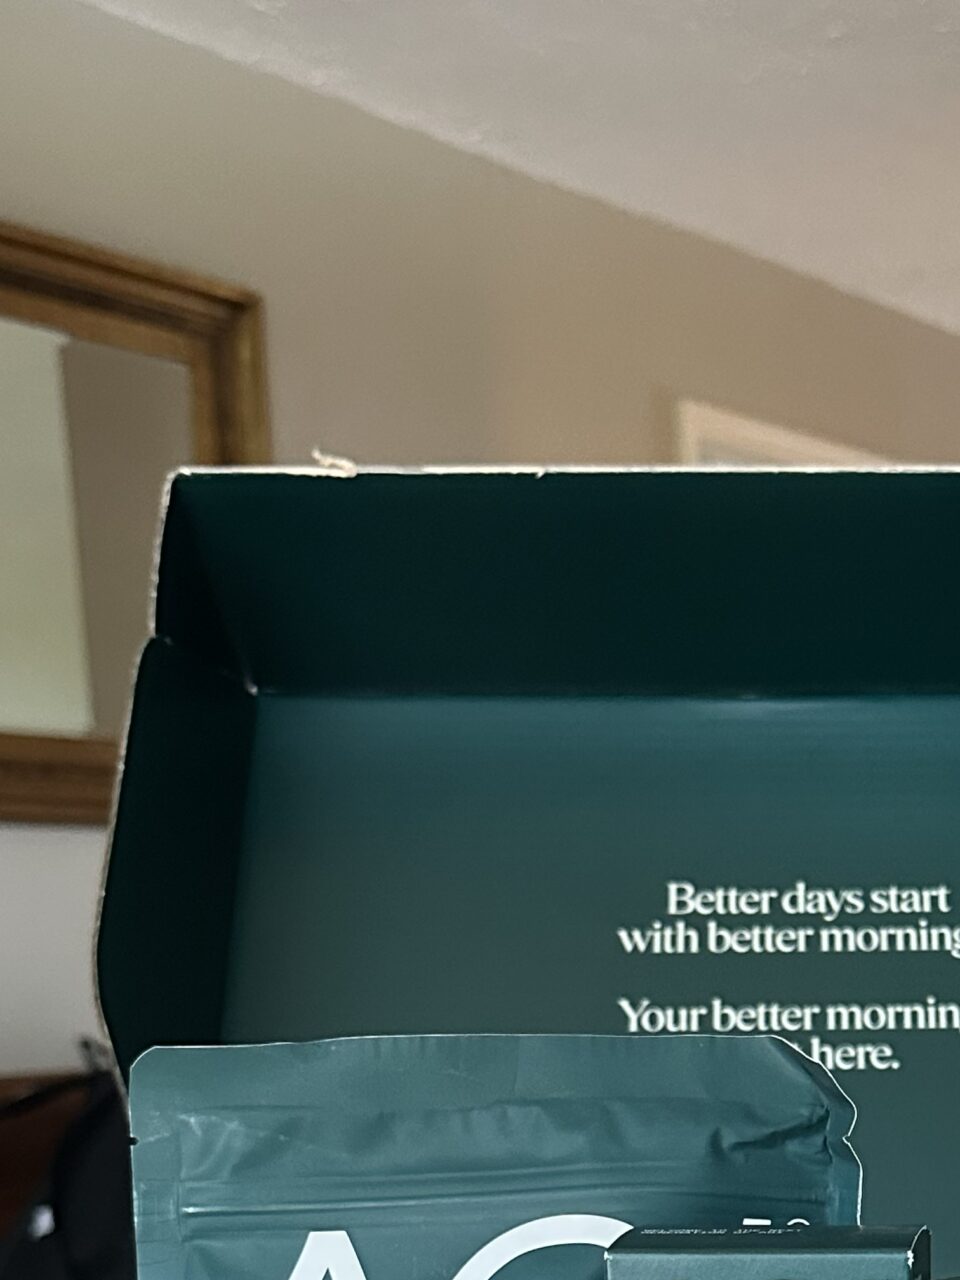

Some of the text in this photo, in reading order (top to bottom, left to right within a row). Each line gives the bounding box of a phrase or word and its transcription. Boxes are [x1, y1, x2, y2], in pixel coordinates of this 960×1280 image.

[667, 881, 951, 921] Better days start
[617, 920, 700, 954] with
[707, 920, 814, 954] better
[617, 997, 708, 1033] Your
[712, 998, 821, 1032] better
[810, 1036, 901, 1070] here.
